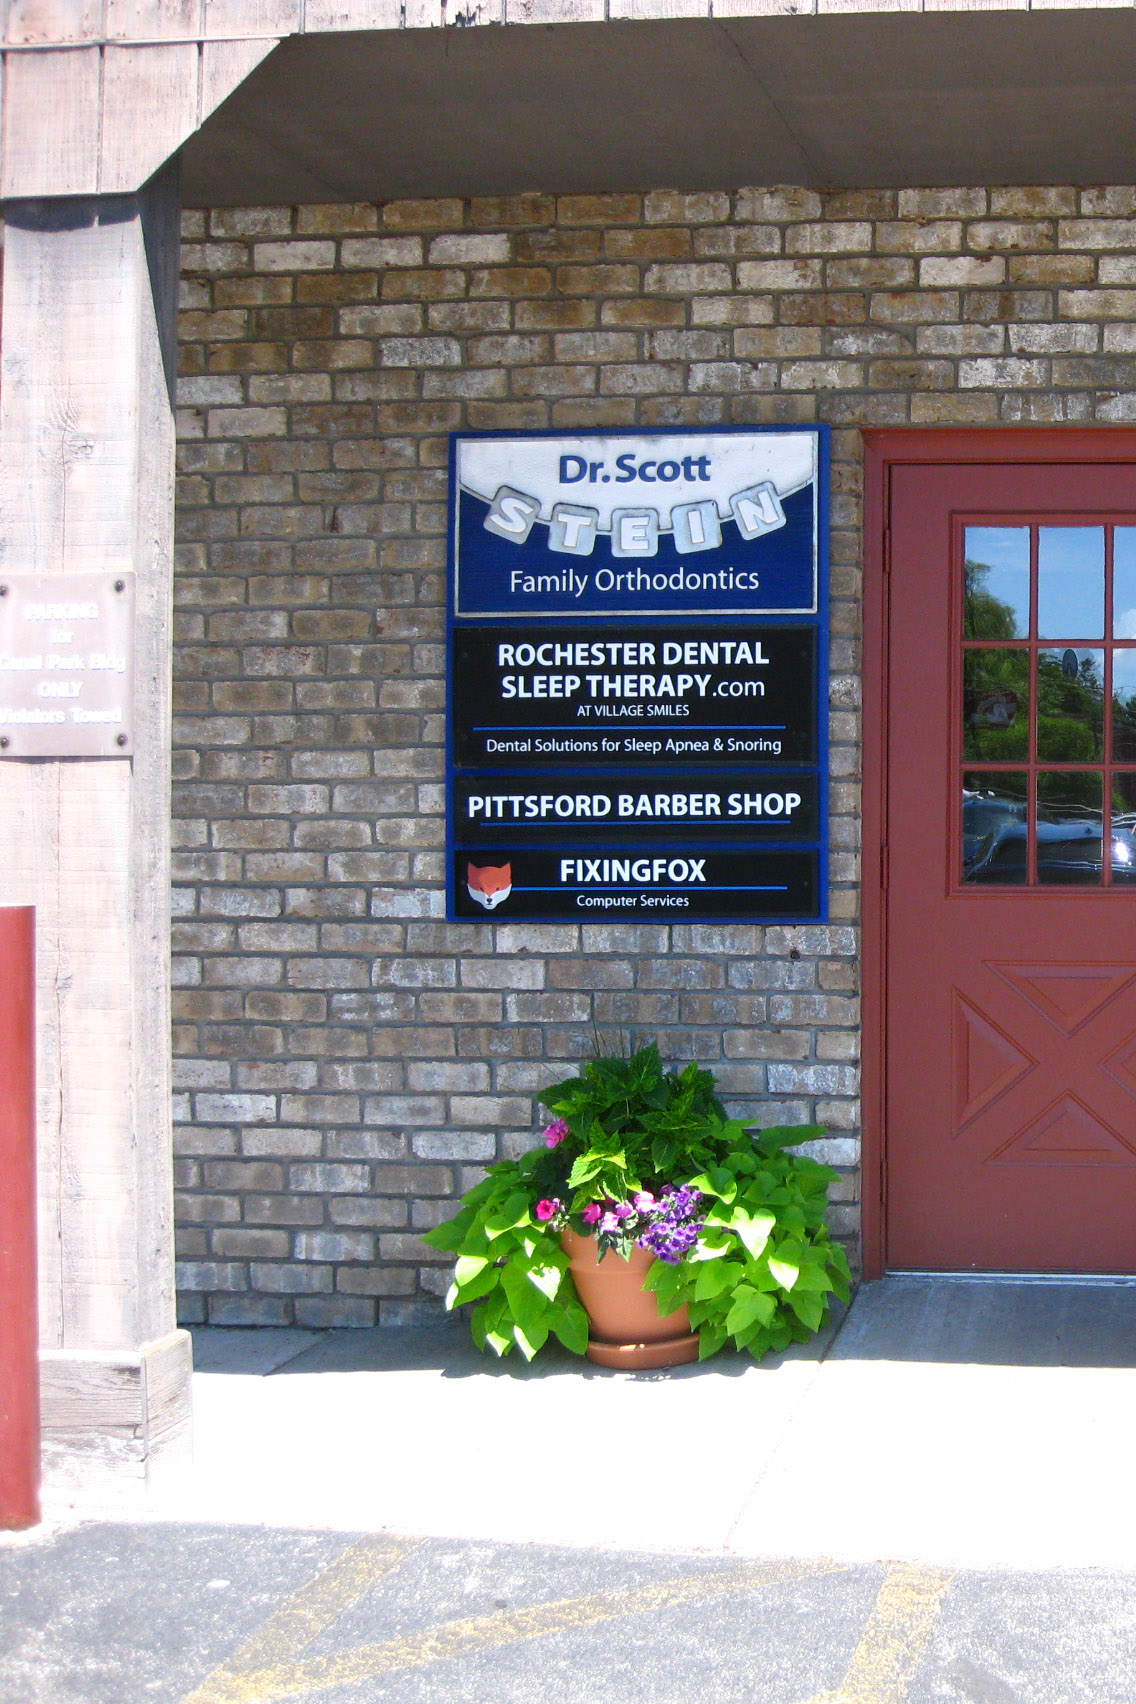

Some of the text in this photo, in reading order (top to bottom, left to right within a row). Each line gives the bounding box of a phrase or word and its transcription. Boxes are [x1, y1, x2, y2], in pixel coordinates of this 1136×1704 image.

[489, 490, 780, 550] STEIN
[510, 567, 759, 598] Family Orthodontics
[498, 641, 770, 667] ROCHESTER DENTAL
[38, 681, 83, 698] ONLY
[501, 674, 766, 698] SLEEP THERAPY.com
[577, 704, 690, 717] AT VILLAGE SMILES
[486, 737, 782, 755] Dental Solutions for Sleep Apnea & Snoring
[468, 793, 801, 818] PITTSFORD BARBER SHOP
[560, 859, 707, 882] FIXINGFOX
[577, 895, 689, 908] Computer Services
